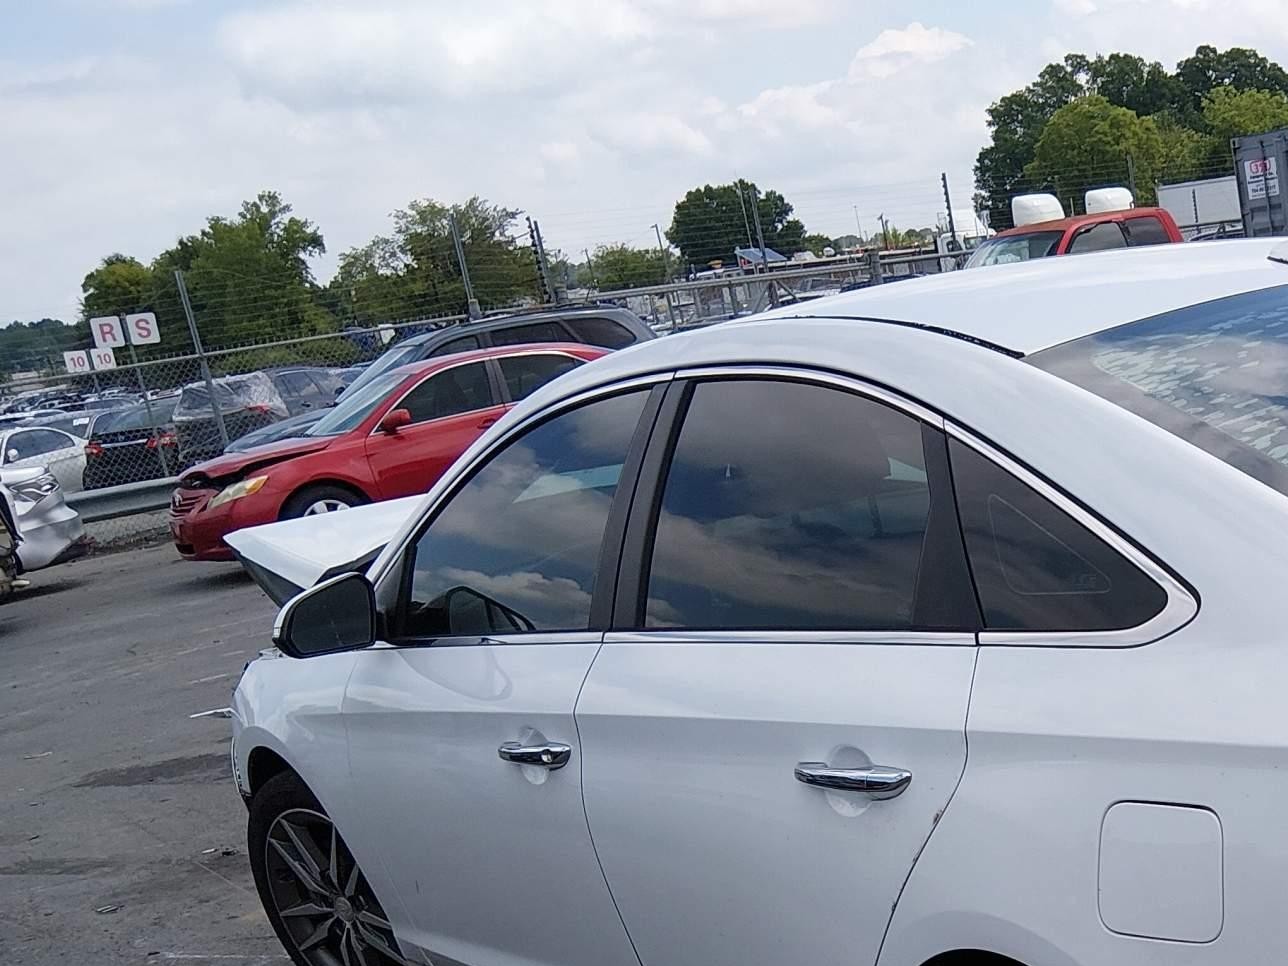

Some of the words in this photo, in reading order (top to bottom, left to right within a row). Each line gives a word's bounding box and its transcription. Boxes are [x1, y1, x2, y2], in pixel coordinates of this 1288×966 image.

[99, 323, 117, 343] R
[135, 318, 152, 338] S
[70, 356, 85, 368] 10
[97, 353, 112, 365] 10
